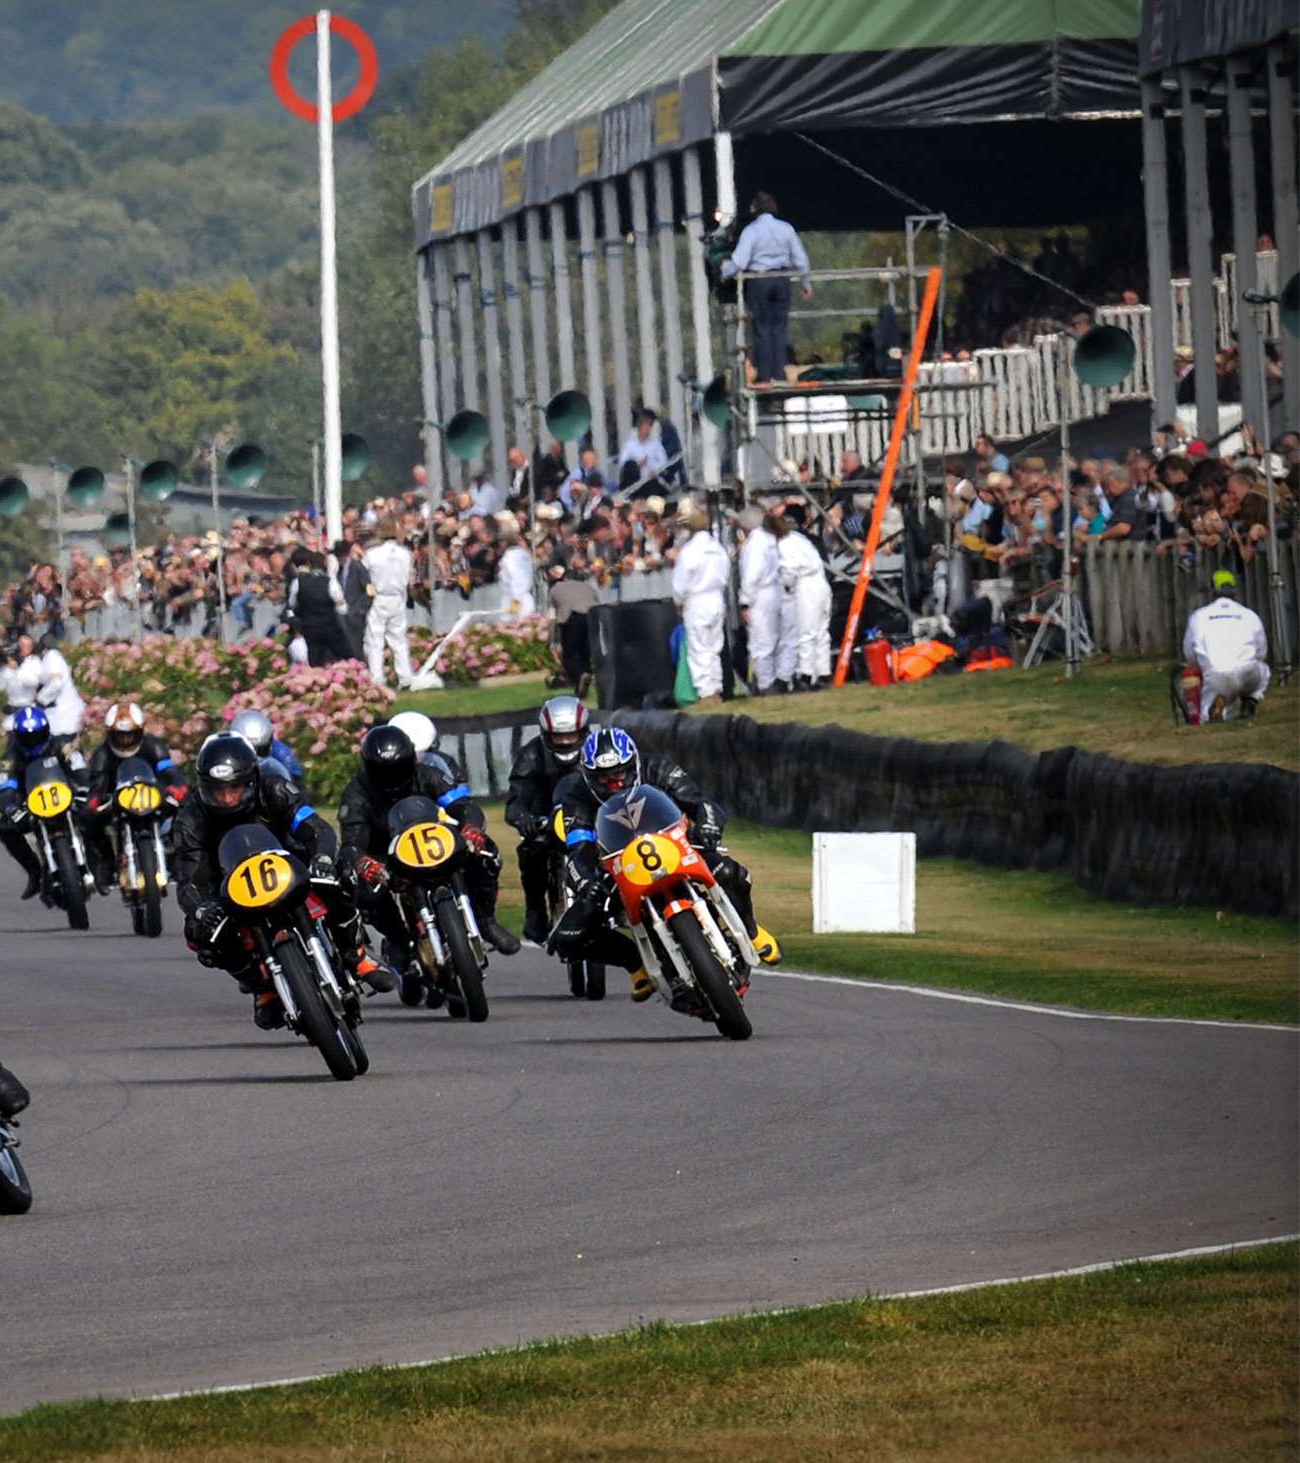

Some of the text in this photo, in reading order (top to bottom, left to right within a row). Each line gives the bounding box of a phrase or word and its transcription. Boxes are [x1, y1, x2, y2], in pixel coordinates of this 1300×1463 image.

[37, 786, 60, 811] 18
[407, 826, 446, 865] 15
[636, 840, 663, 872] 8
[239, 858, 279, 899] 16
